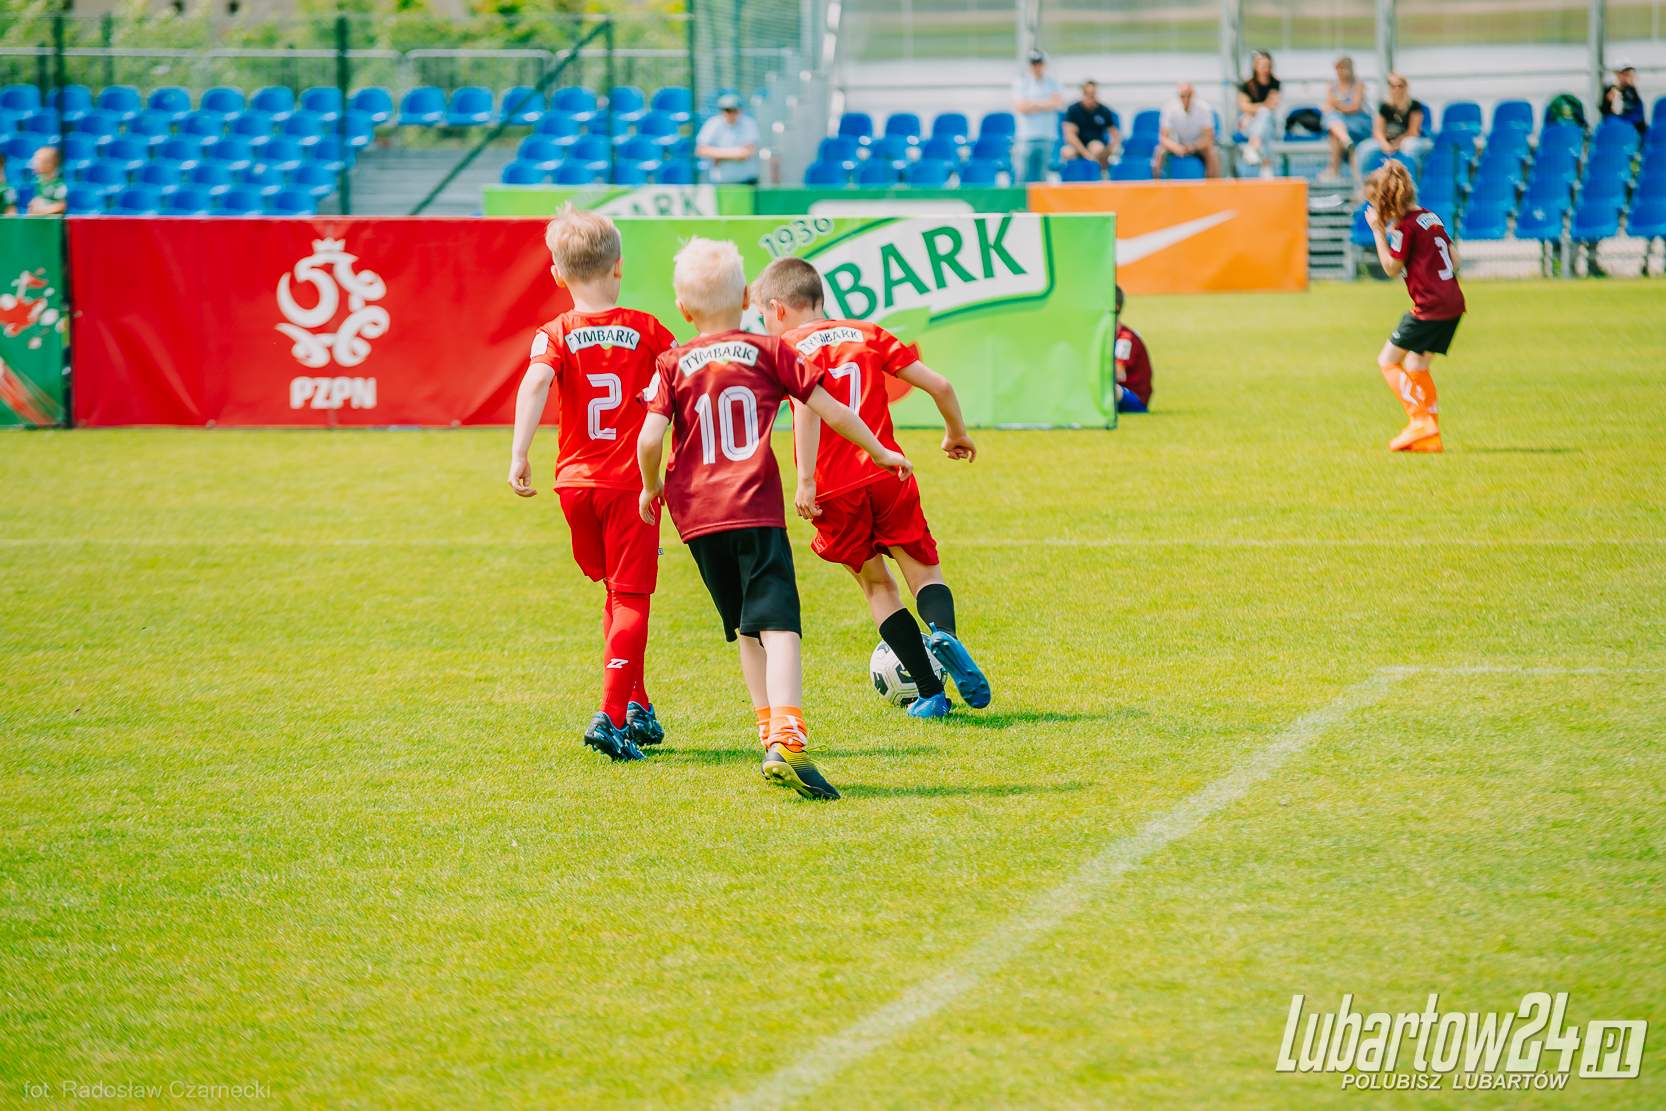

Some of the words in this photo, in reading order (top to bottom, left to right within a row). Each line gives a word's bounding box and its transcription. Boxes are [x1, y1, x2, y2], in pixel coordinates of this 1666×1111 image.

[745, 216, 1028, 332] BARK
[568, 329, 636, 346] YMBARK
[683, 345, 753, 370] TYMBARK
[289, 376, 378, 410] PZPN
[586, 373, 622, 440] 2
[828, 362, 861, 417] 7
[694, 386, 759, 465] 10
